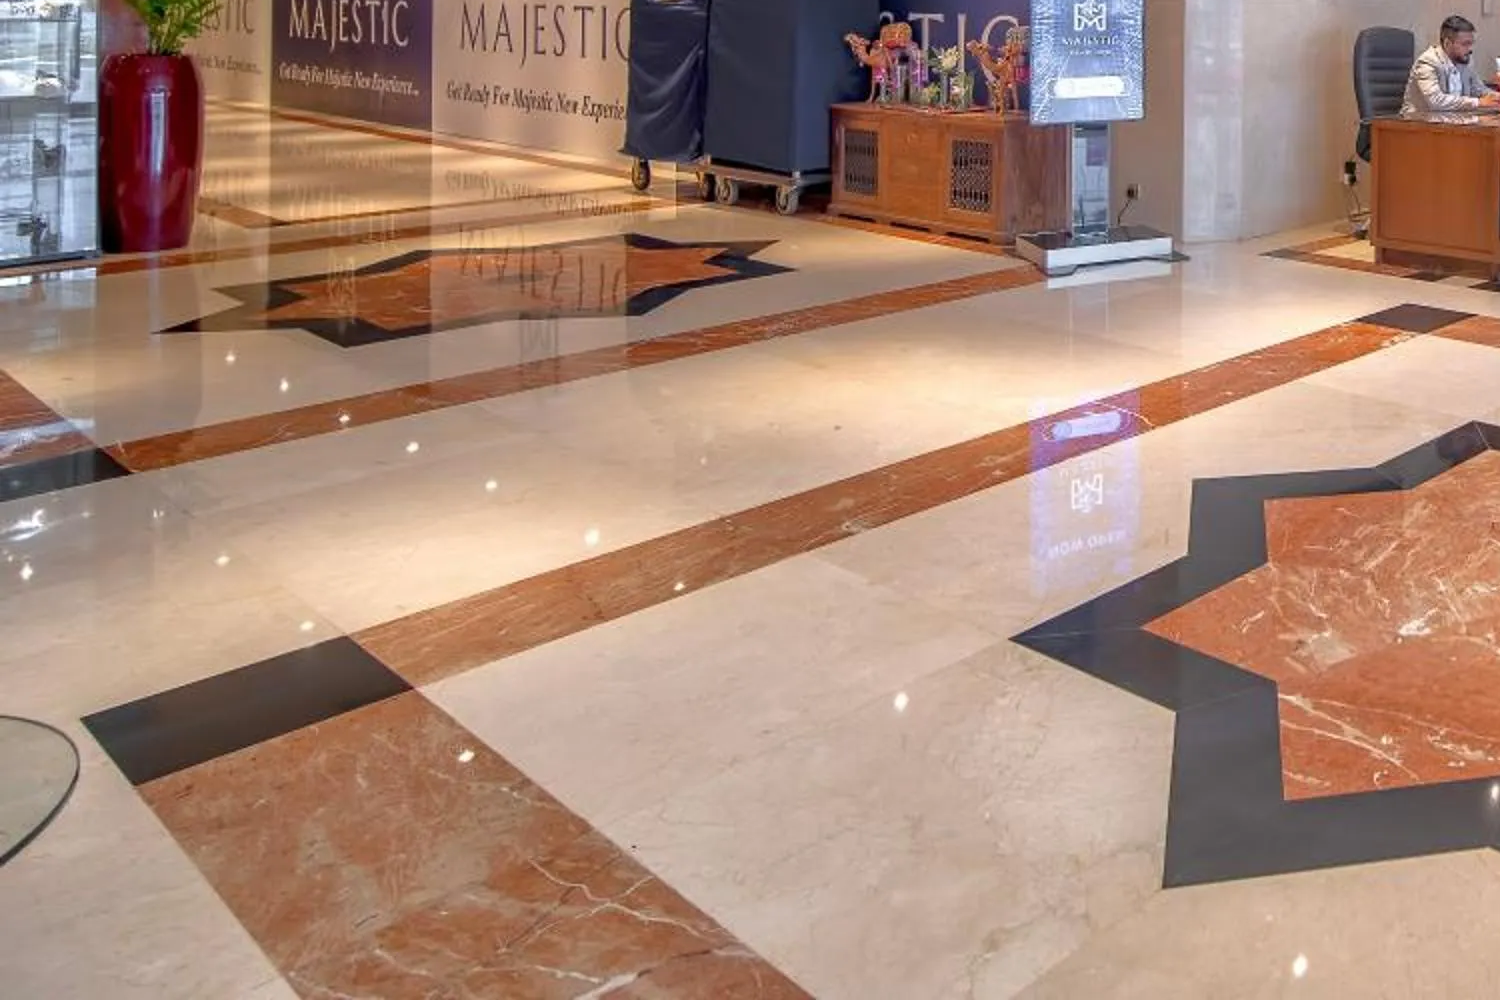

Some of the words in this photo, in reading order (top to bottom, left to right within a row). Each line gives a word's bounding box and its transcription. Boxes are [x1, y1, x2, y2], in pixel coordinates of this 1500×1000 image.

[460, 2, 631, 69] MAJESTIC
[446, 80, 463, 99] Get
[463, 83, 490, 109] Ready
[493, 85, 510, 106] For
[511, 87, 553, 114] Majestic
[554, 92, 578, 115] New
[581, 95, 626, 123] Experie
